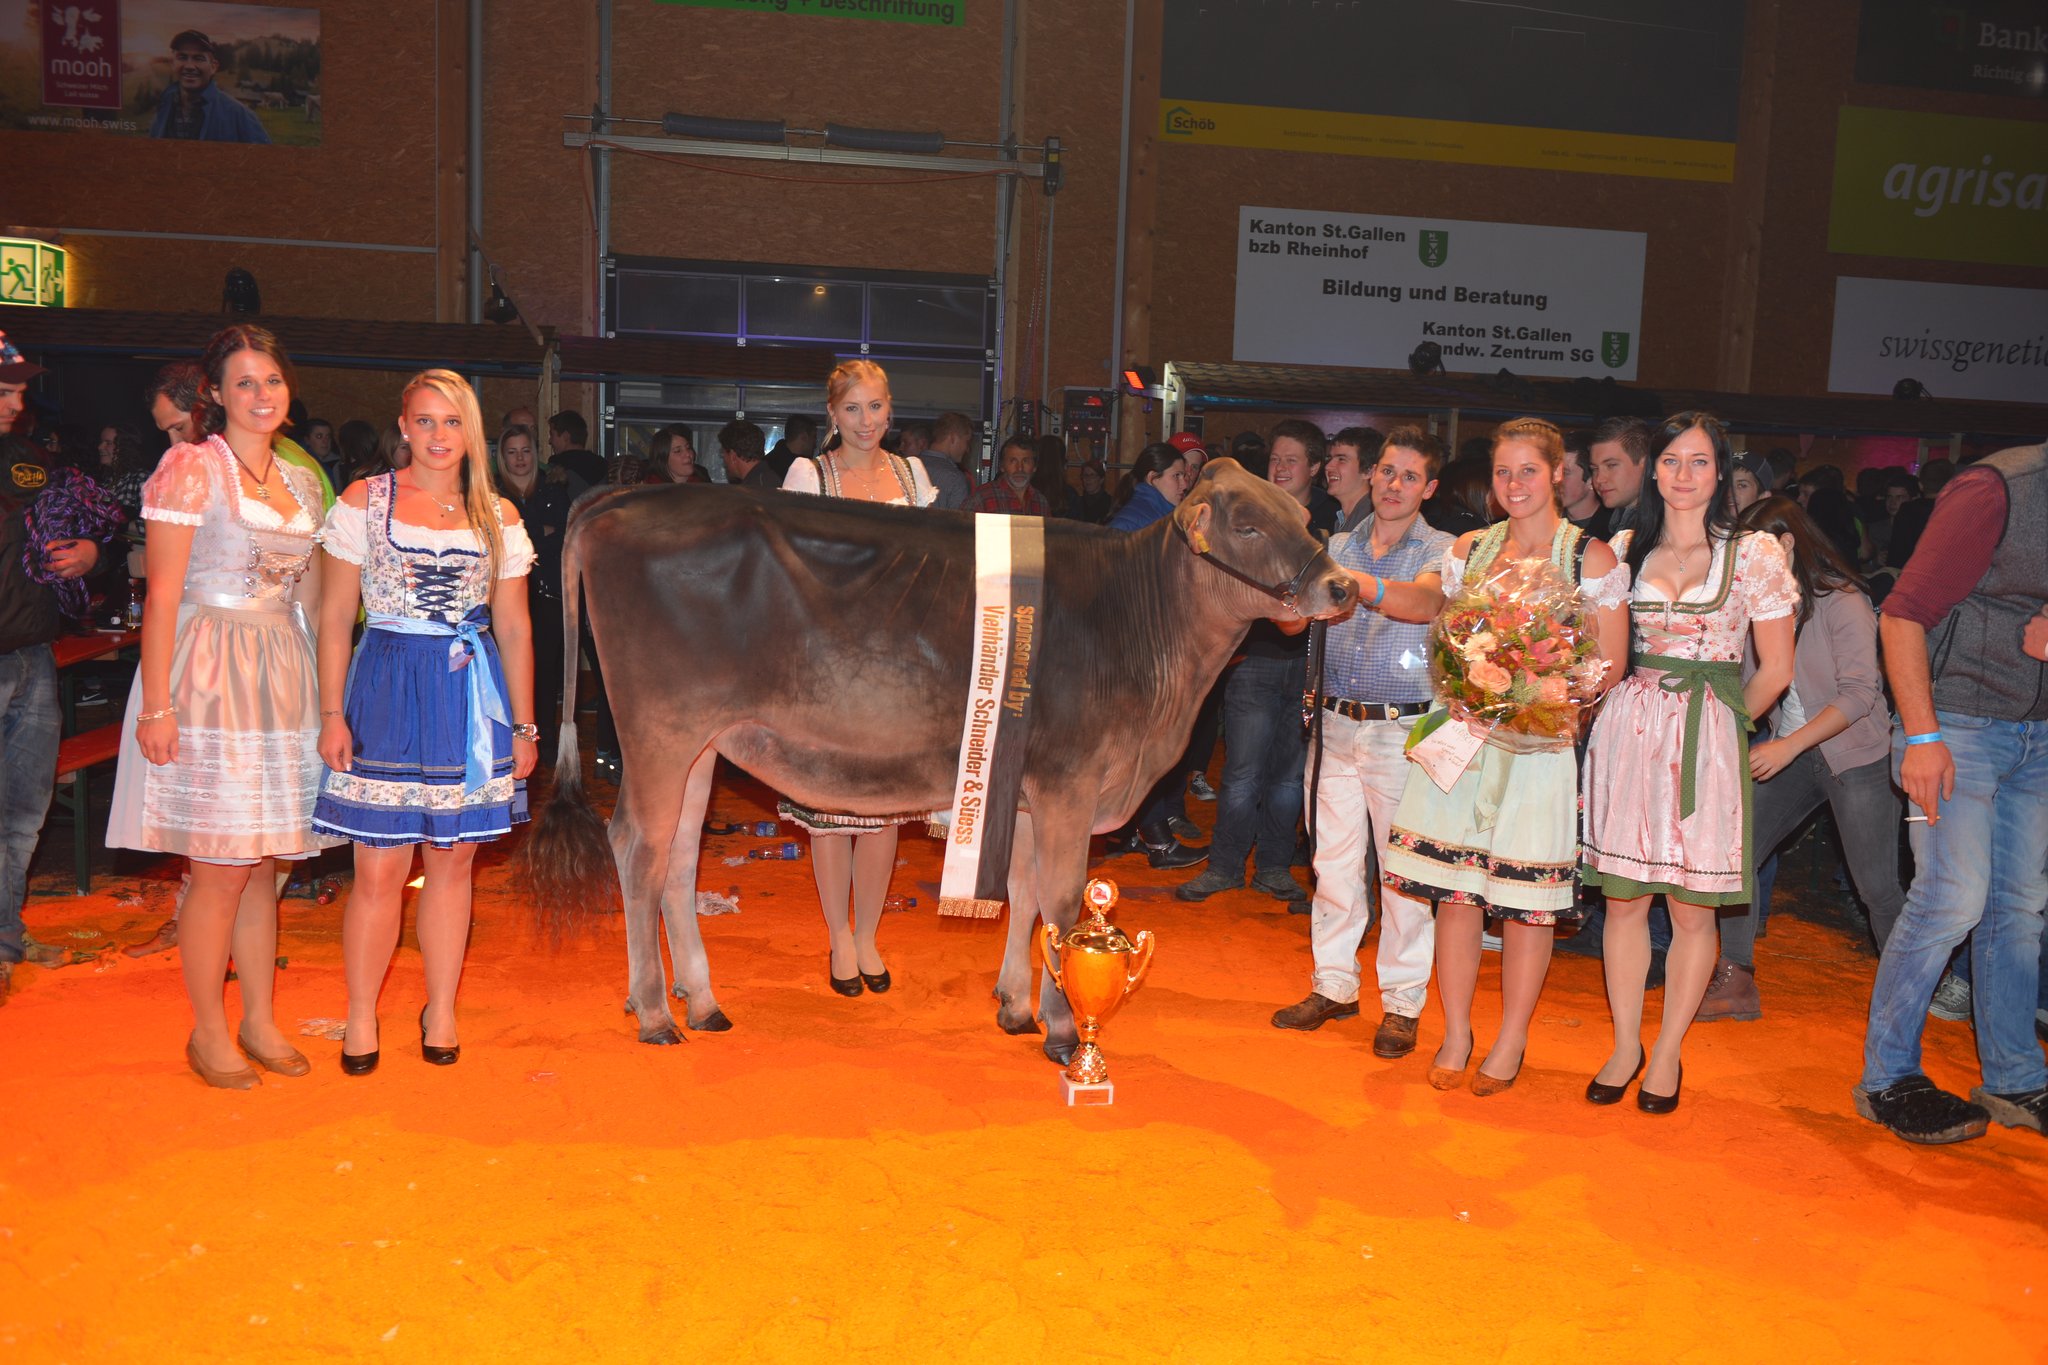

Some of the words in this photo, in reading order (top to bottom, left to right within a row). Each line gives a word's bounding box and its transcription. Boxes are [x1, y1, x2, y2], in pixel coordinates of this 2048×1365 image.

[1976, 22, 2048, 53] Bank
[51, 57, 112, 78] mooh
[1973, 64, 2024, 84] Richtig
[28, 115, 137, 131] www.mooh.swiss
[1174, 116, 1216, 131] Schöb
[1882, 154, 2048, 218] agrisa
[1249, 219, 1316, 238] Kanton
[1322, 223, 1406, 243] St.Gallen
[1249, 239, 1281, 254] bzb
[1287, 241, 1369, 259] Rheinhof
[1322, 279, 1402, 302] Bildung
[1409, 285, 1447, 302] und
[1454, 286, 1548, 310] Beratung
[1422, 321, 1486, 338] Kanton
[1492, 325, 1572, 343] St.Gallen
[1422, 341, 1485, 357] ndw.
[1490, 344, 1564, 361] Zentrum
[1570, 348, 1594, 362] SG
[977, 605, 1005, 694] Viehhändler
[1011, 605, 1035, 690] sponsored
[965, 698, 995, 777] Schneider
[963, 779, 983, 793] &
[955, 796, 981, 845] Süess
